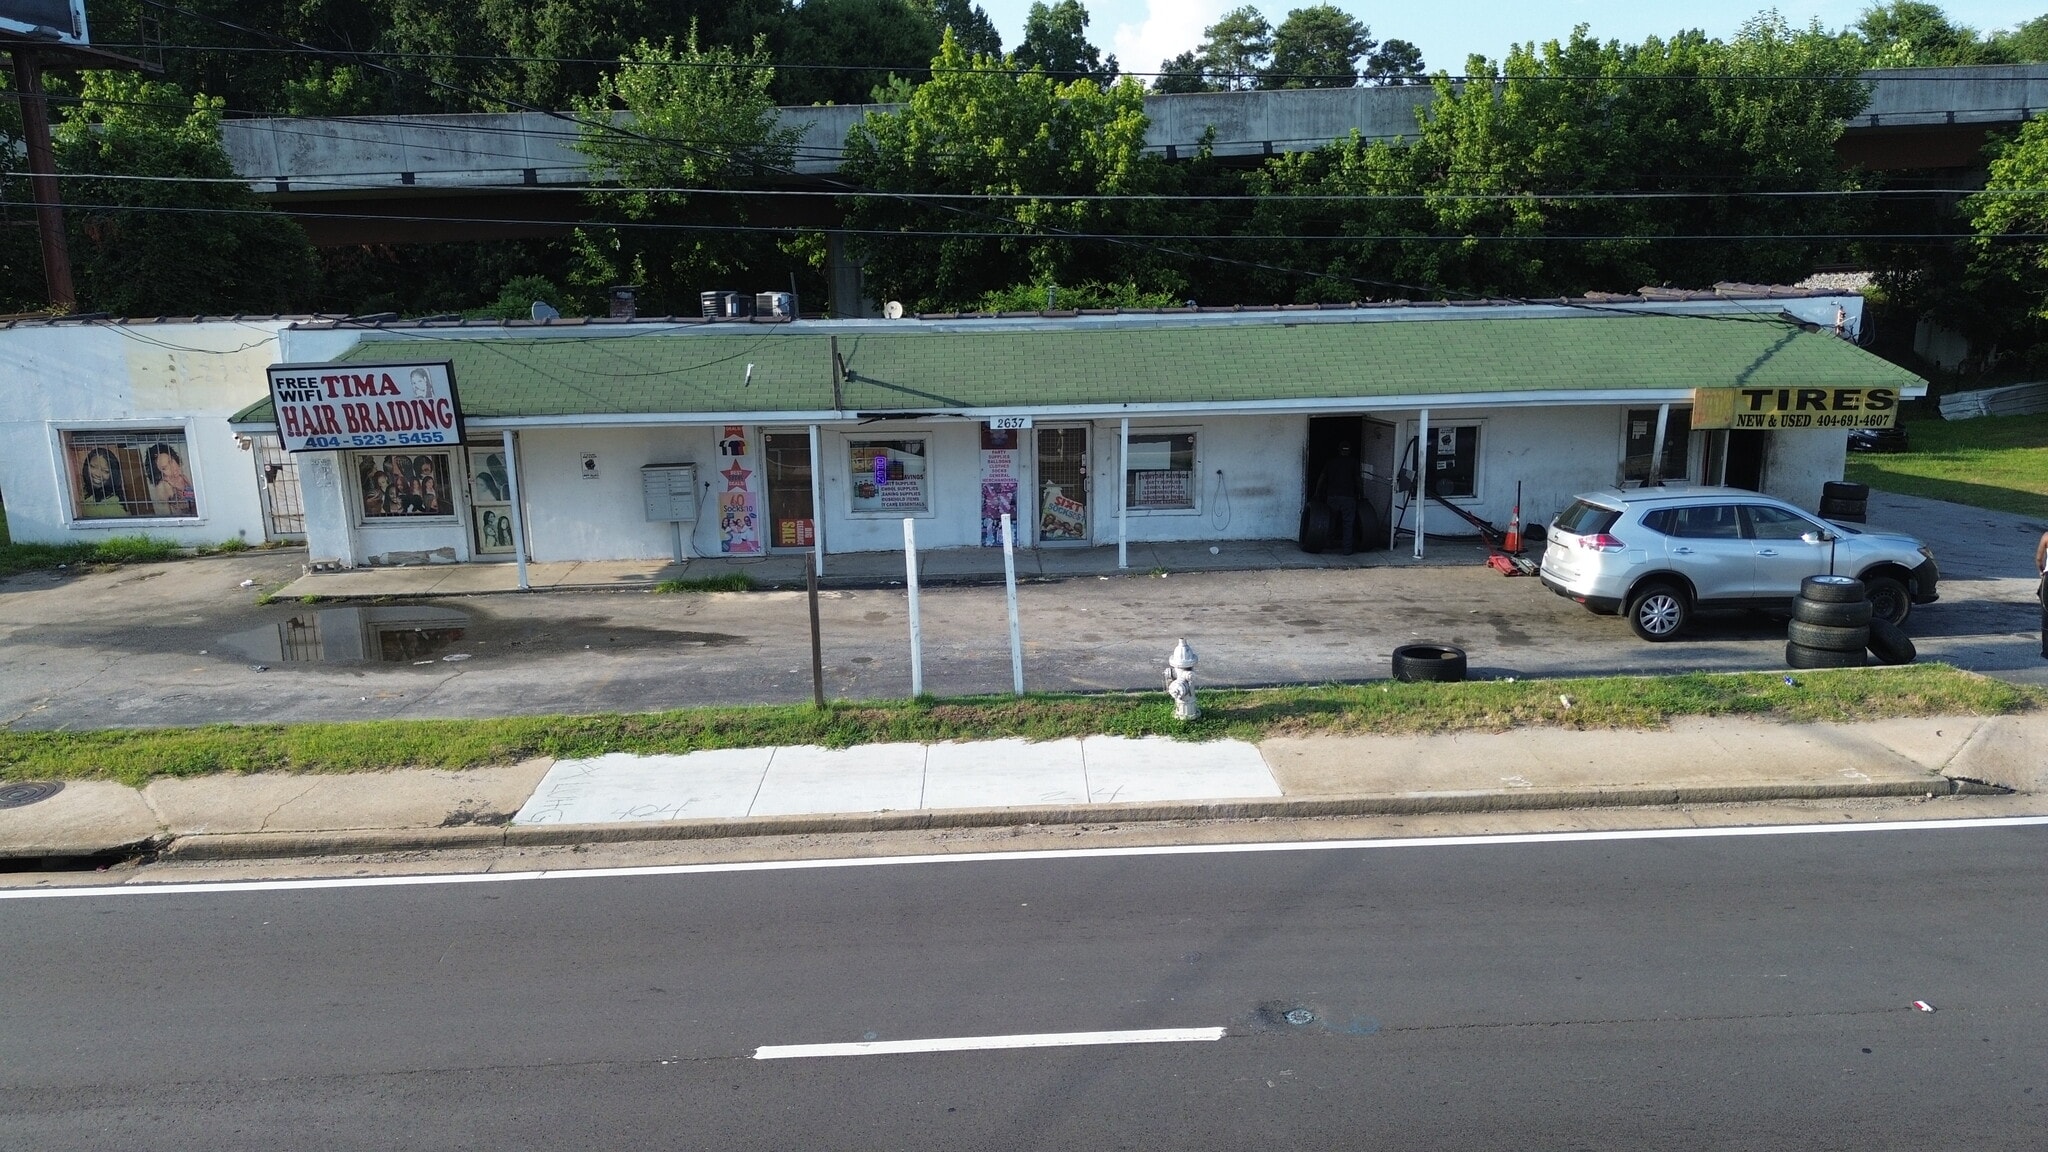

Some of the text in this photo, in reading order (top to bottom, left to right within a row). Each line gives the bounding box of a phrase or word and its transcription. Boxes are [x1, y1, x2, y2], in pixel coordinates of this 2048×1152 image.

[275, 377, 319, 390] FREE
[320, 373, 401, 399] TIMA
[278, 389, 323, 402] WIFI
[1741, 388, 1895, 411] TIRES
[281, 398, 454, 438] HAIR BRAIDING
[997, 418, 1025, 428] 2637
[1736, 414, 1890, 428] NEW & USED 404-691-4607
[730, 494, 745, 507] 60
[723, 505, 744, 513] Socks
[782, 521, 796, 544] SALE
